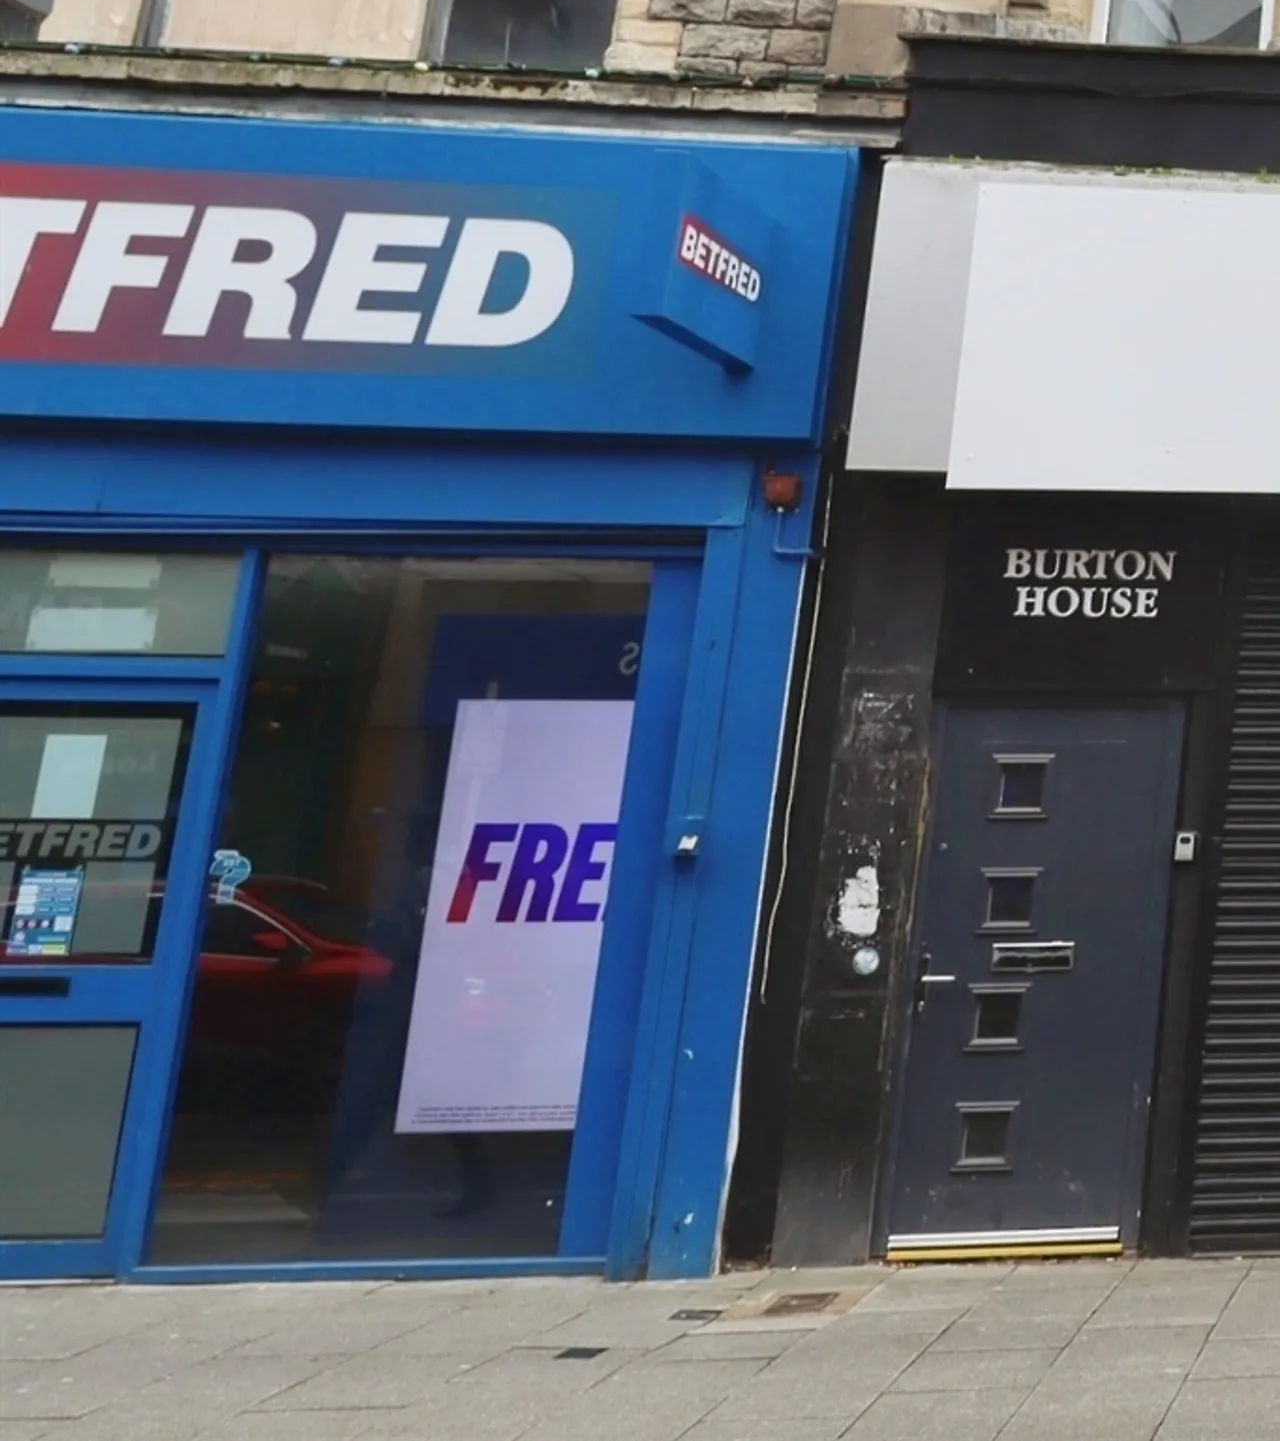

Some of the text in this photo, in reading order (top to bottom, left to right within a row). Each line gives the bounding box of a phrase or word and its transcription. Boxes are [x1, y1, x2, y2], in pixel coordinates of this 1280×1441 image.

[0, 197, 575, 347] TFRED
[680, 224, 762, 303] BETFRED
[1003, 548, 1178, 582] BURTON
[1013, 585, 1160, 618] HOUSE
[446, 823, 618, 924] FRE
